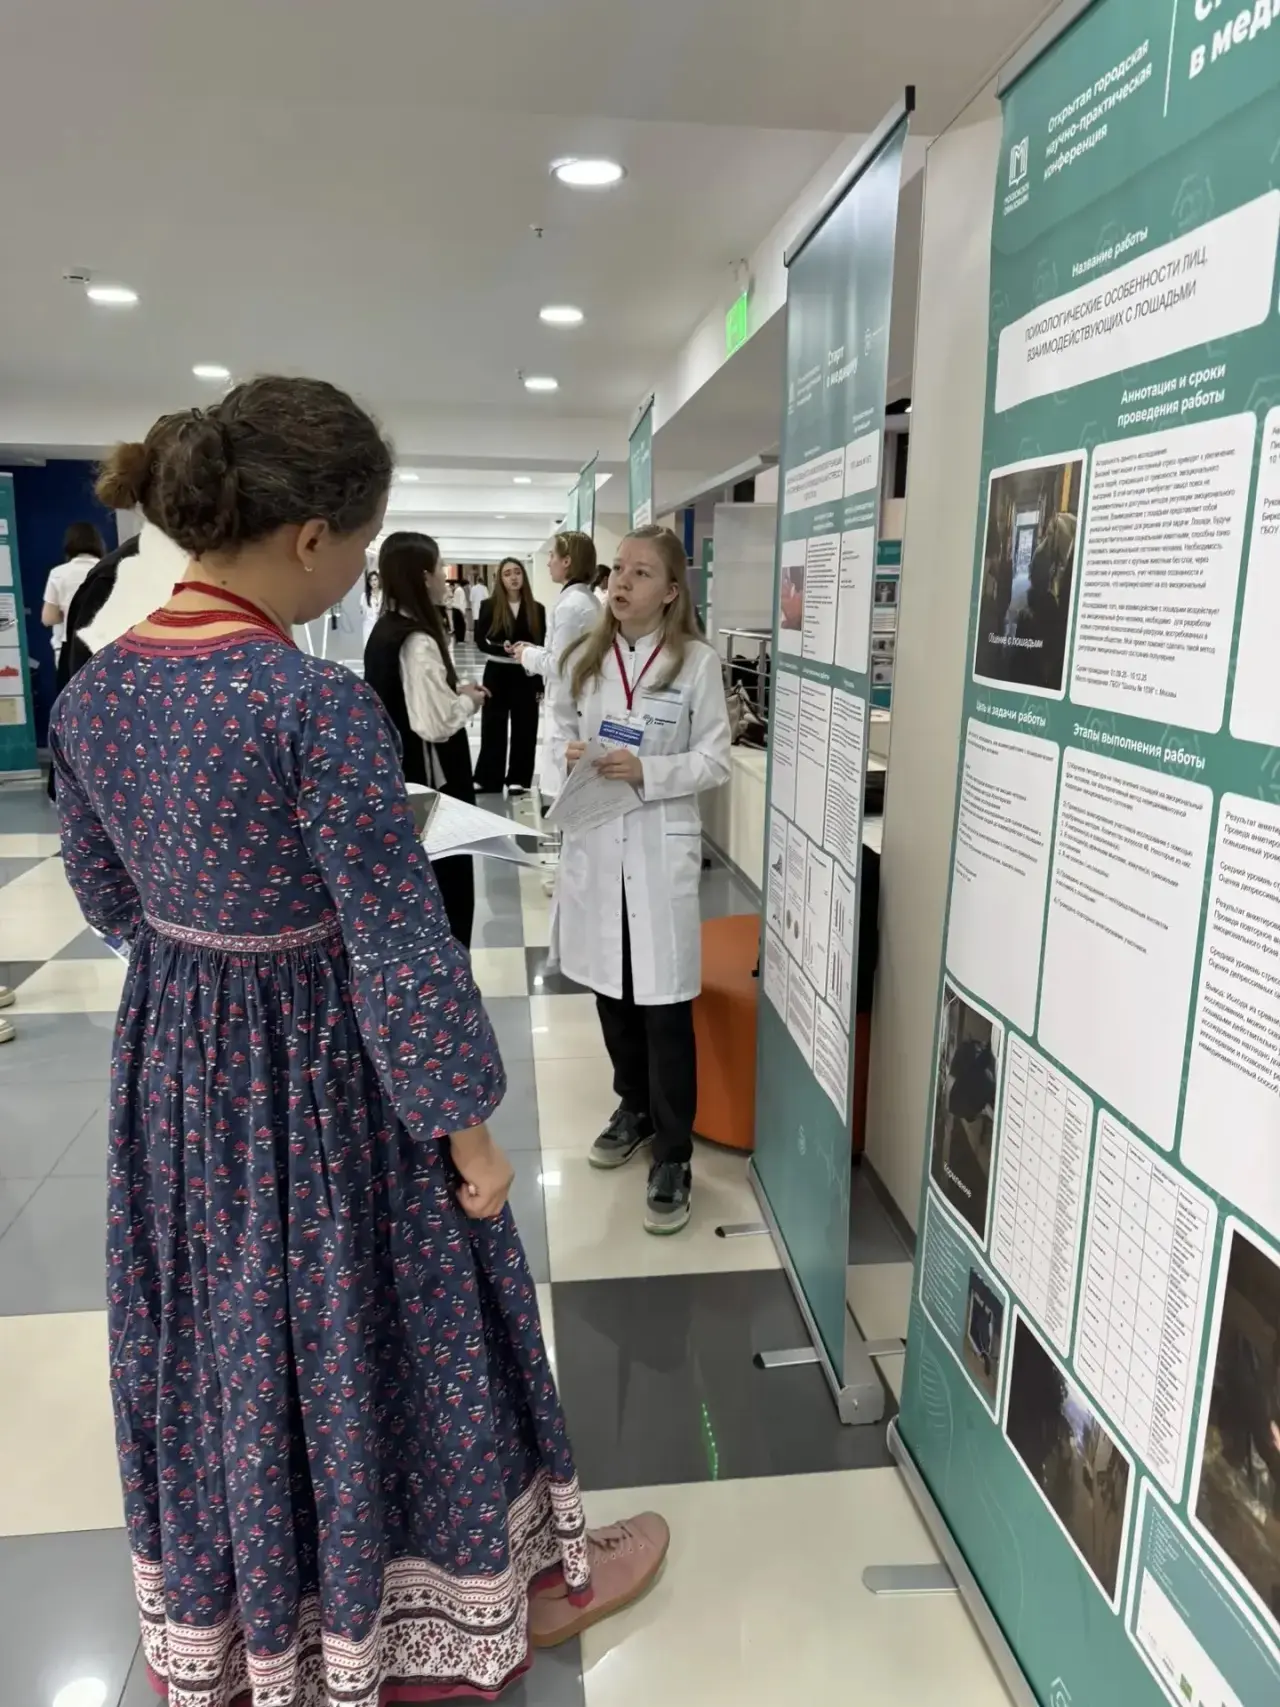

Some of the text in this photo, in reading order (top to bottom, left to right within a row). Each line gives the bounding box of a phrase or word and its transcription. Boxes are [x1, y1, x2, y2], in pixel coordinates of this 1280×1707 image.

[1048, 39, 1149, 133] Открытая городская
[1188, 44, 1206, 80] в
[1045, 62, 1152, 159] научно-практическая
[1043, 123, 1107, 182] конференция
[1071, 226, 1148, 277] Название работы
[1024, 294, 1103, 342] ПСИХОЛОГИЧЕСКИЕ
[1104, 258, 1181, 308] ОСОБЕННОСТИ
[1027, 279, 1197, 362] ВЗАИМОДЕЙСТВУЮЩИХ С ЛОШАДЬМИ
[1117, 387, 1226, 429] проведения работы
[1120, 363, 1226, 405] Аннотация и сроки
[991, 706, 1017, 720] задачи
[1017, 711, 1047, 727] работы
[1073, 722, 1206, 770] Этапы выполнения работы
